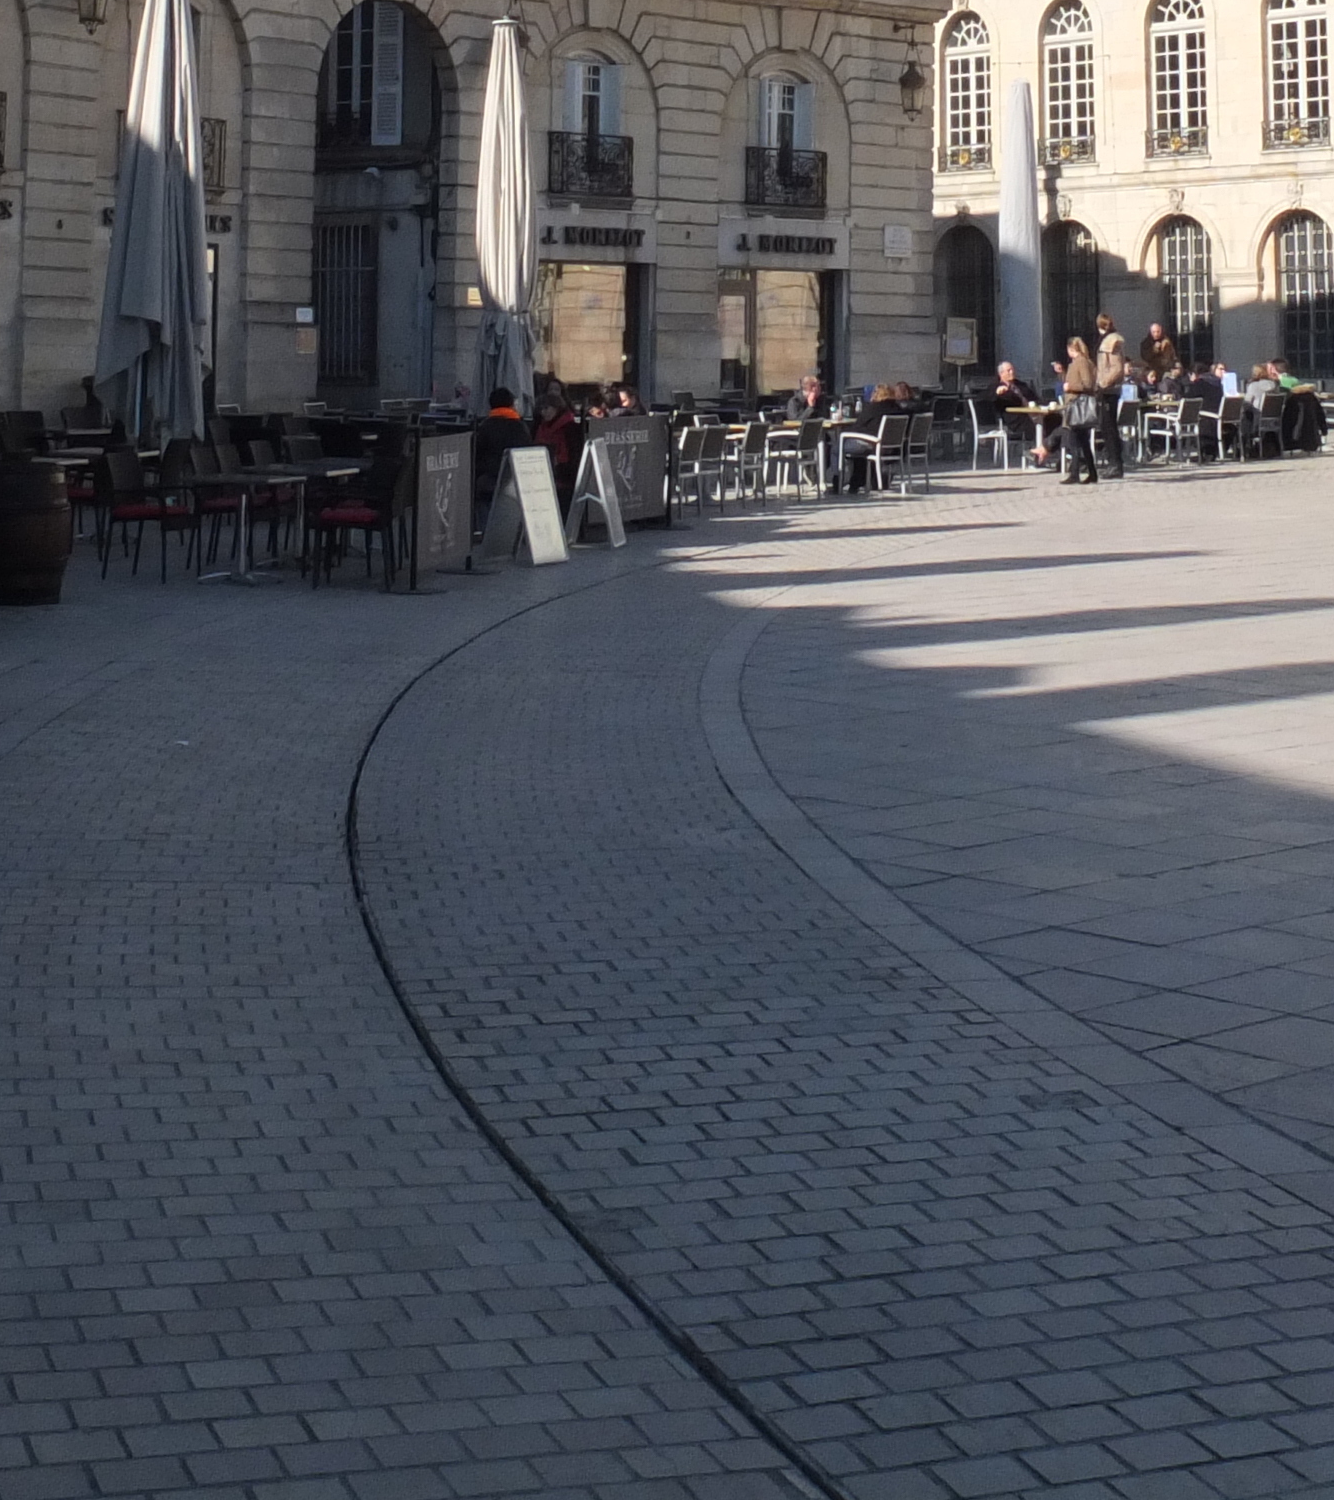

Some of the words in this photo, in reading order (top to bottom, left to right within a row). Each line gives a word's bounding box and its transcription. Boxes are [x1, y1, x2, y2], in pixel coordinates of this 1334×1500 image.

[540, 225, 558, 245] J.
[563, 226, 646, 247] MORIZOT
[736, 233, 752, 252] J.
[757, 234, 837, 254] MORIZOT
